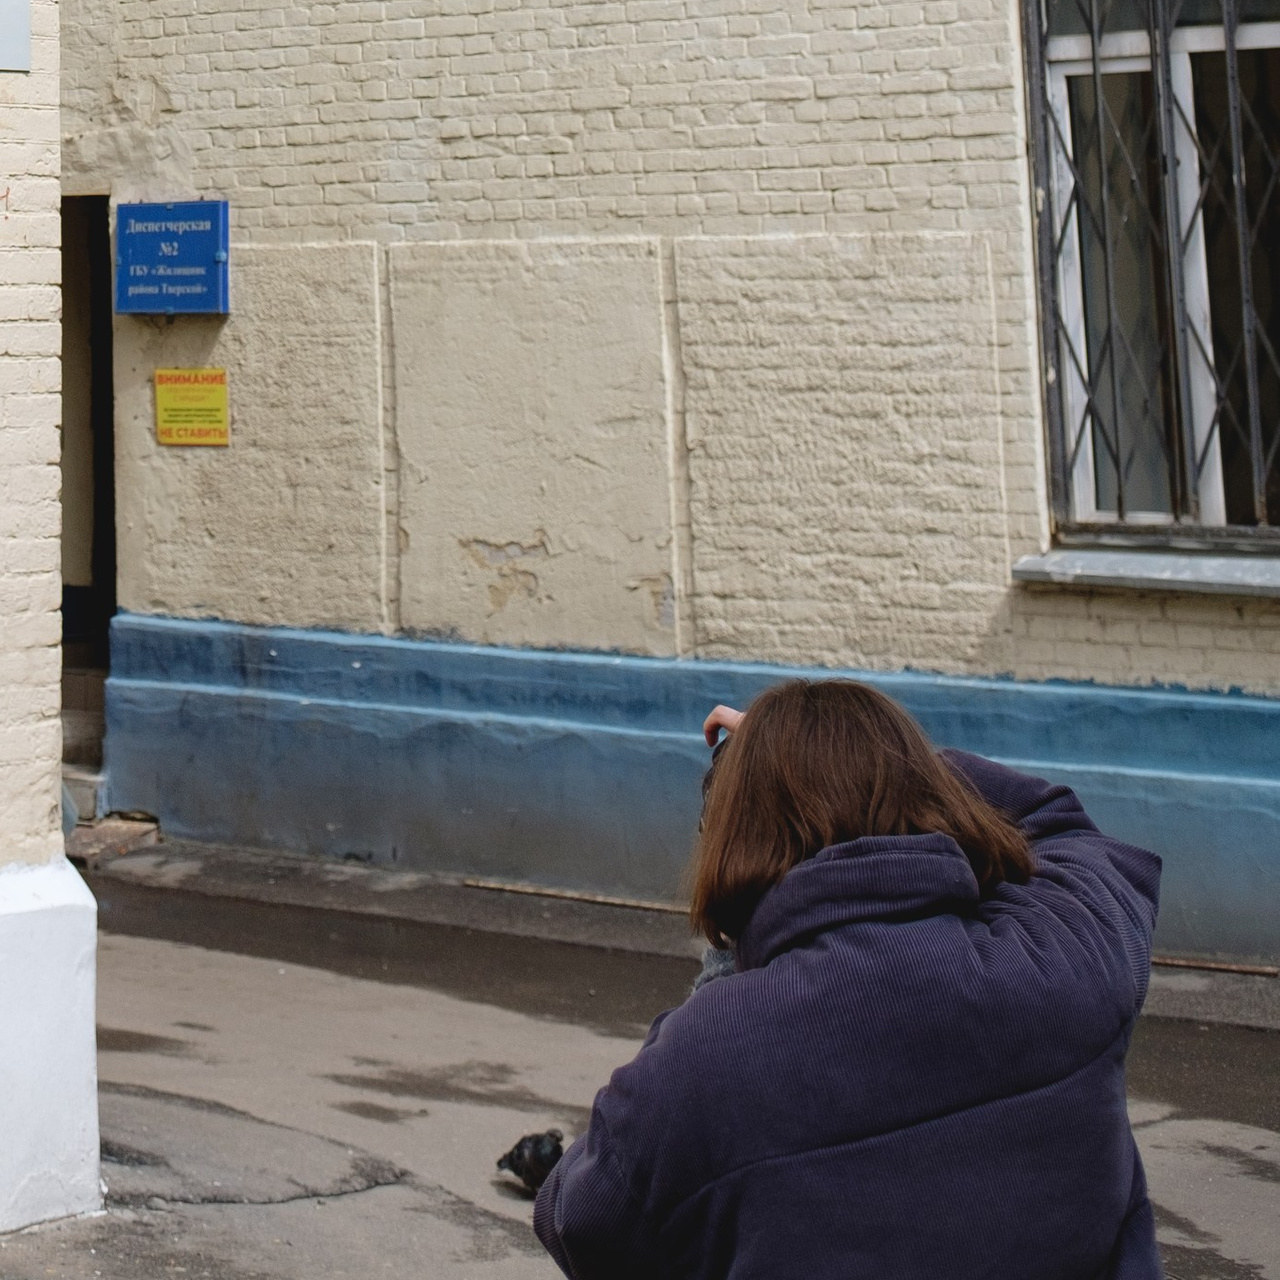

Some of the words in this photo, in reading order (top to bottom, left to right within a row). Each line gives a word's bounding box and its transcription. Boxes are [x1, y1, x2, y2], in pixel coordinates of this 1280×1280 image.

[126, 218, 212, 235] Диспетчерская
[158, 241, 179, 256] №2
[129, 265, 149, 277] ГБУ
[157, 374, 225, 385] ВНИМАНИЕ
[160, 427, 174, 438] НЕ
